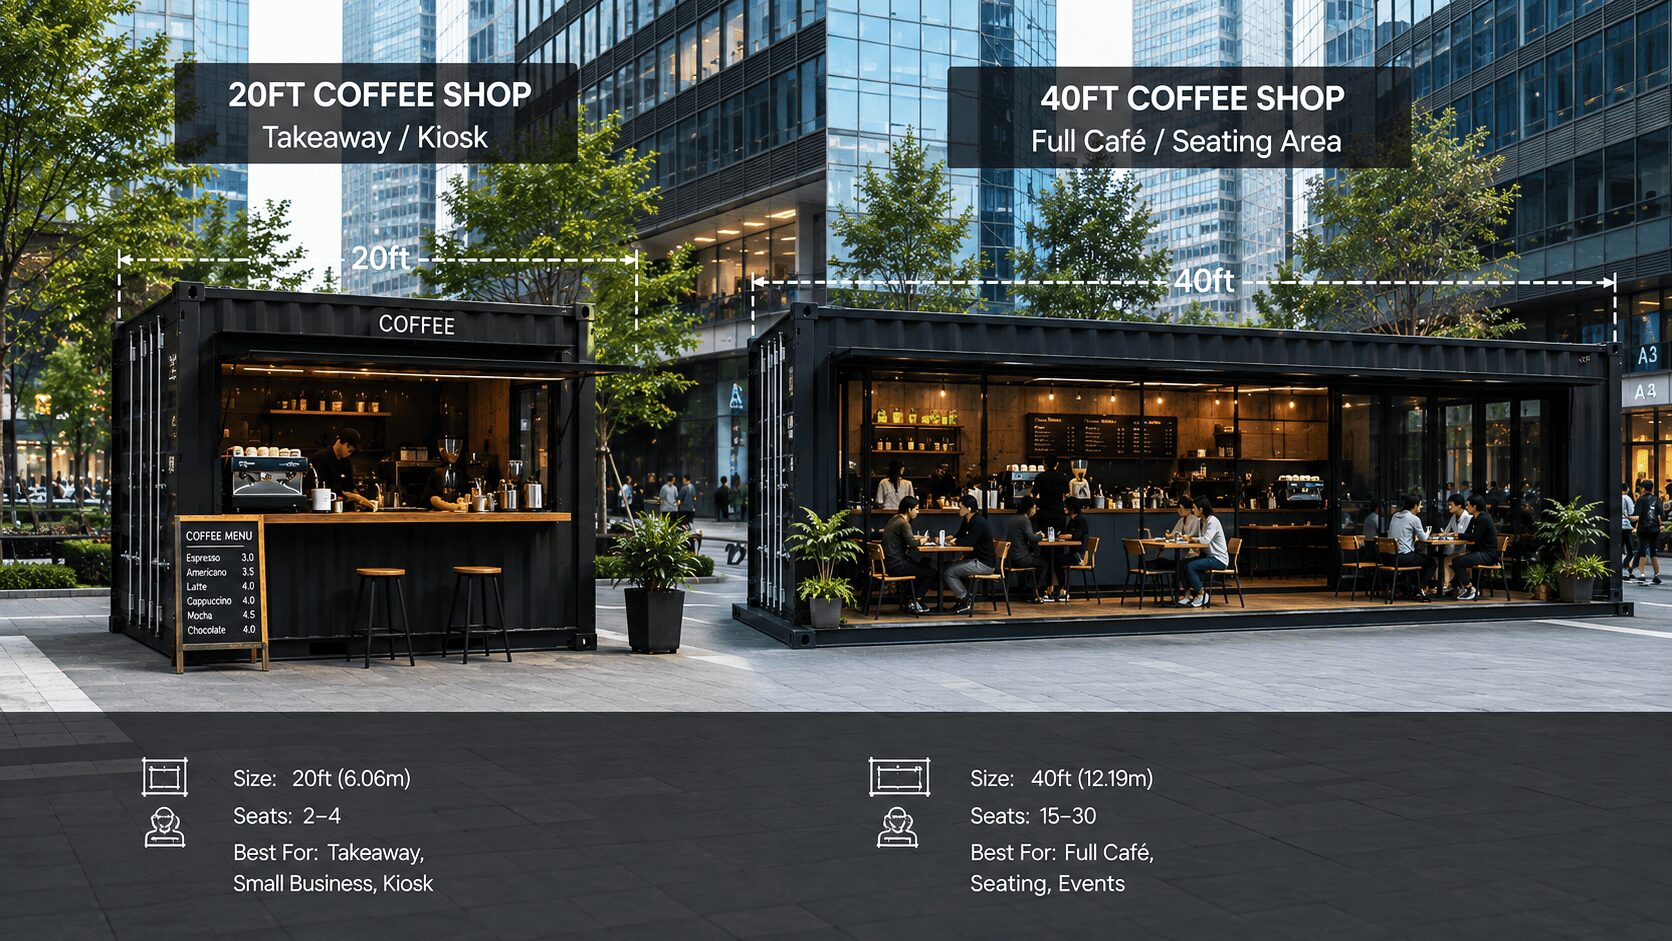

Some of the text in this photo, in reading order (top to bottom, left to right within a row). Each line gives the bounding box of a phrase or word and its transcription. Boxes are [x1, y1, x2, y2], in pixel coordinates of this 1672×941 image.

[379, 313, 455, 336] COFFEE
[1637, 345, 1658, 365] A3
[185, 530, 253, 542] COFFEE MENU
[186, 552, 255, 565] Espresso 3.0
[186, 566, 255, 577] Americano 3.5
[186, 581, 255, 592] Latte 4.0
[186, 595, 256, 608] Cappuccino 4.0
[187, 609, 256, 621] Mocha 4.5
[187, 624, 256, 636] Chocolate 4.0
